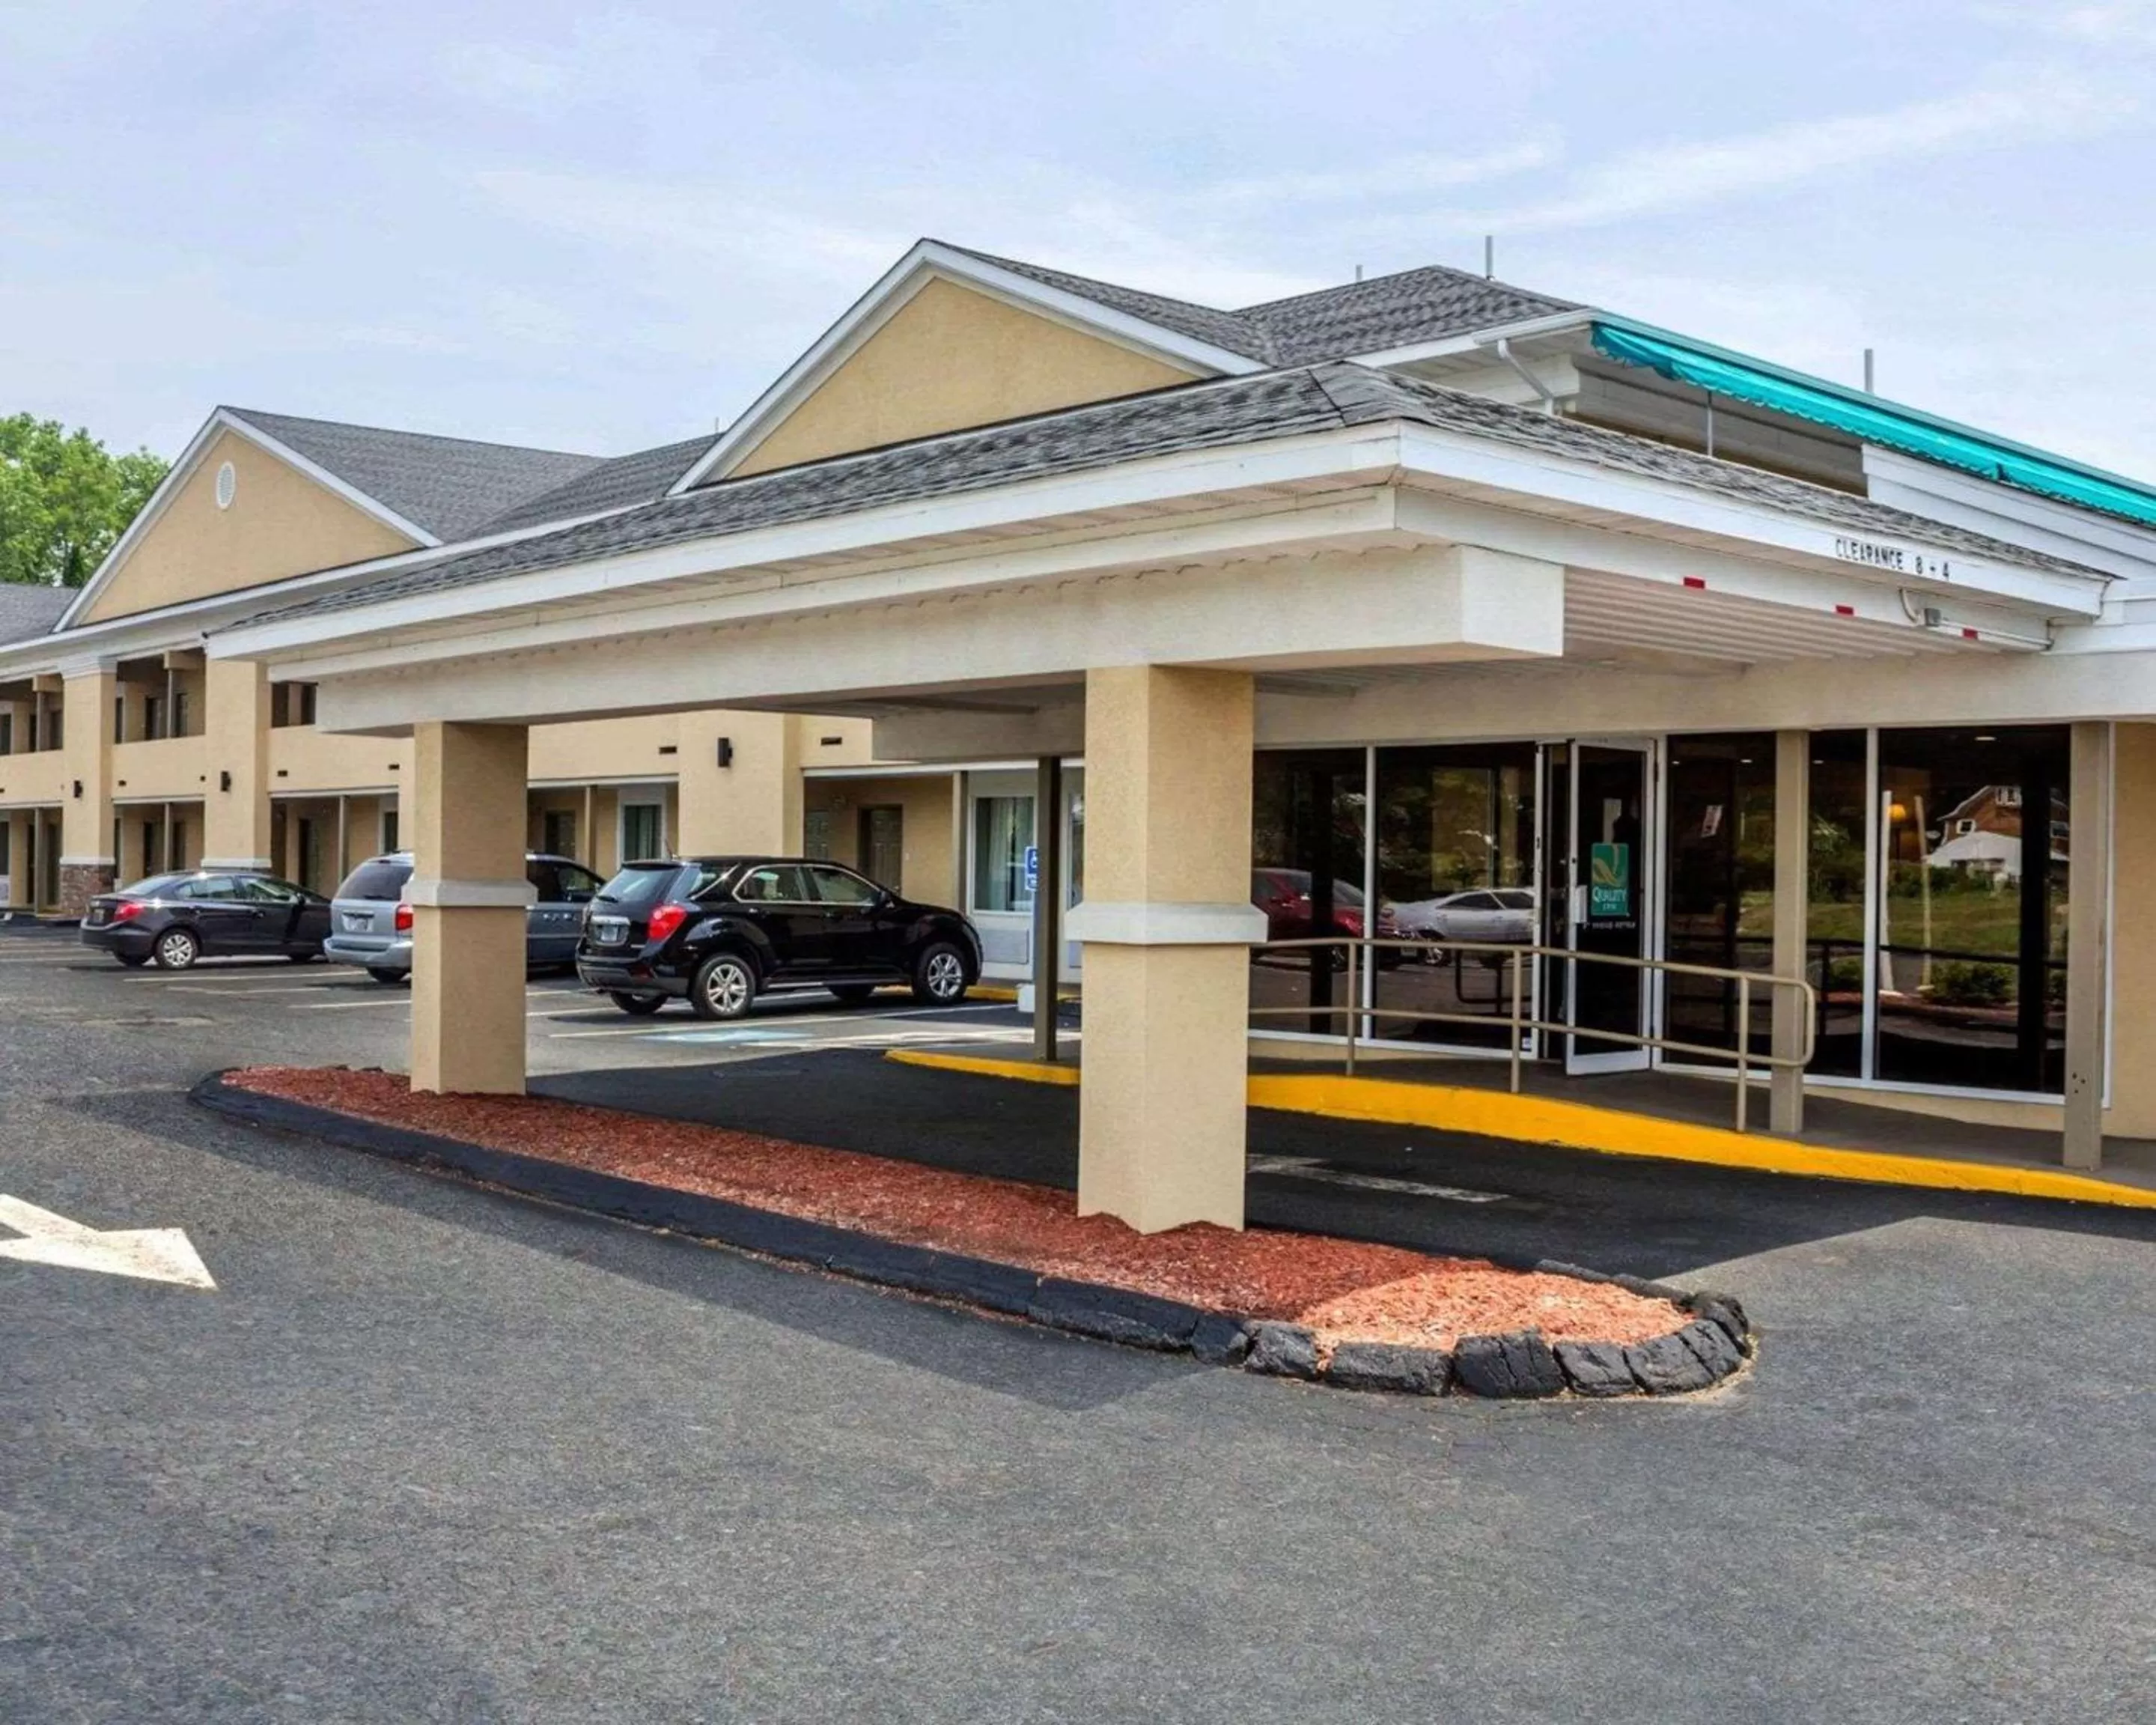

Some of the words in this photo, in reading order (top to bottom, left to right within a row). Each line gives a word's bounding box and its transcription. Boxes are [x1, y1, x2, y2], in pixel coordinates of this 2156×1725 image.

[1836, 538, 1904, 571] CLEARANCE
[1915, 556, 1924, 575] 8
[1942, 562, 1950, 582] 4
[1592, 886, 1627, 903] QUALITY
